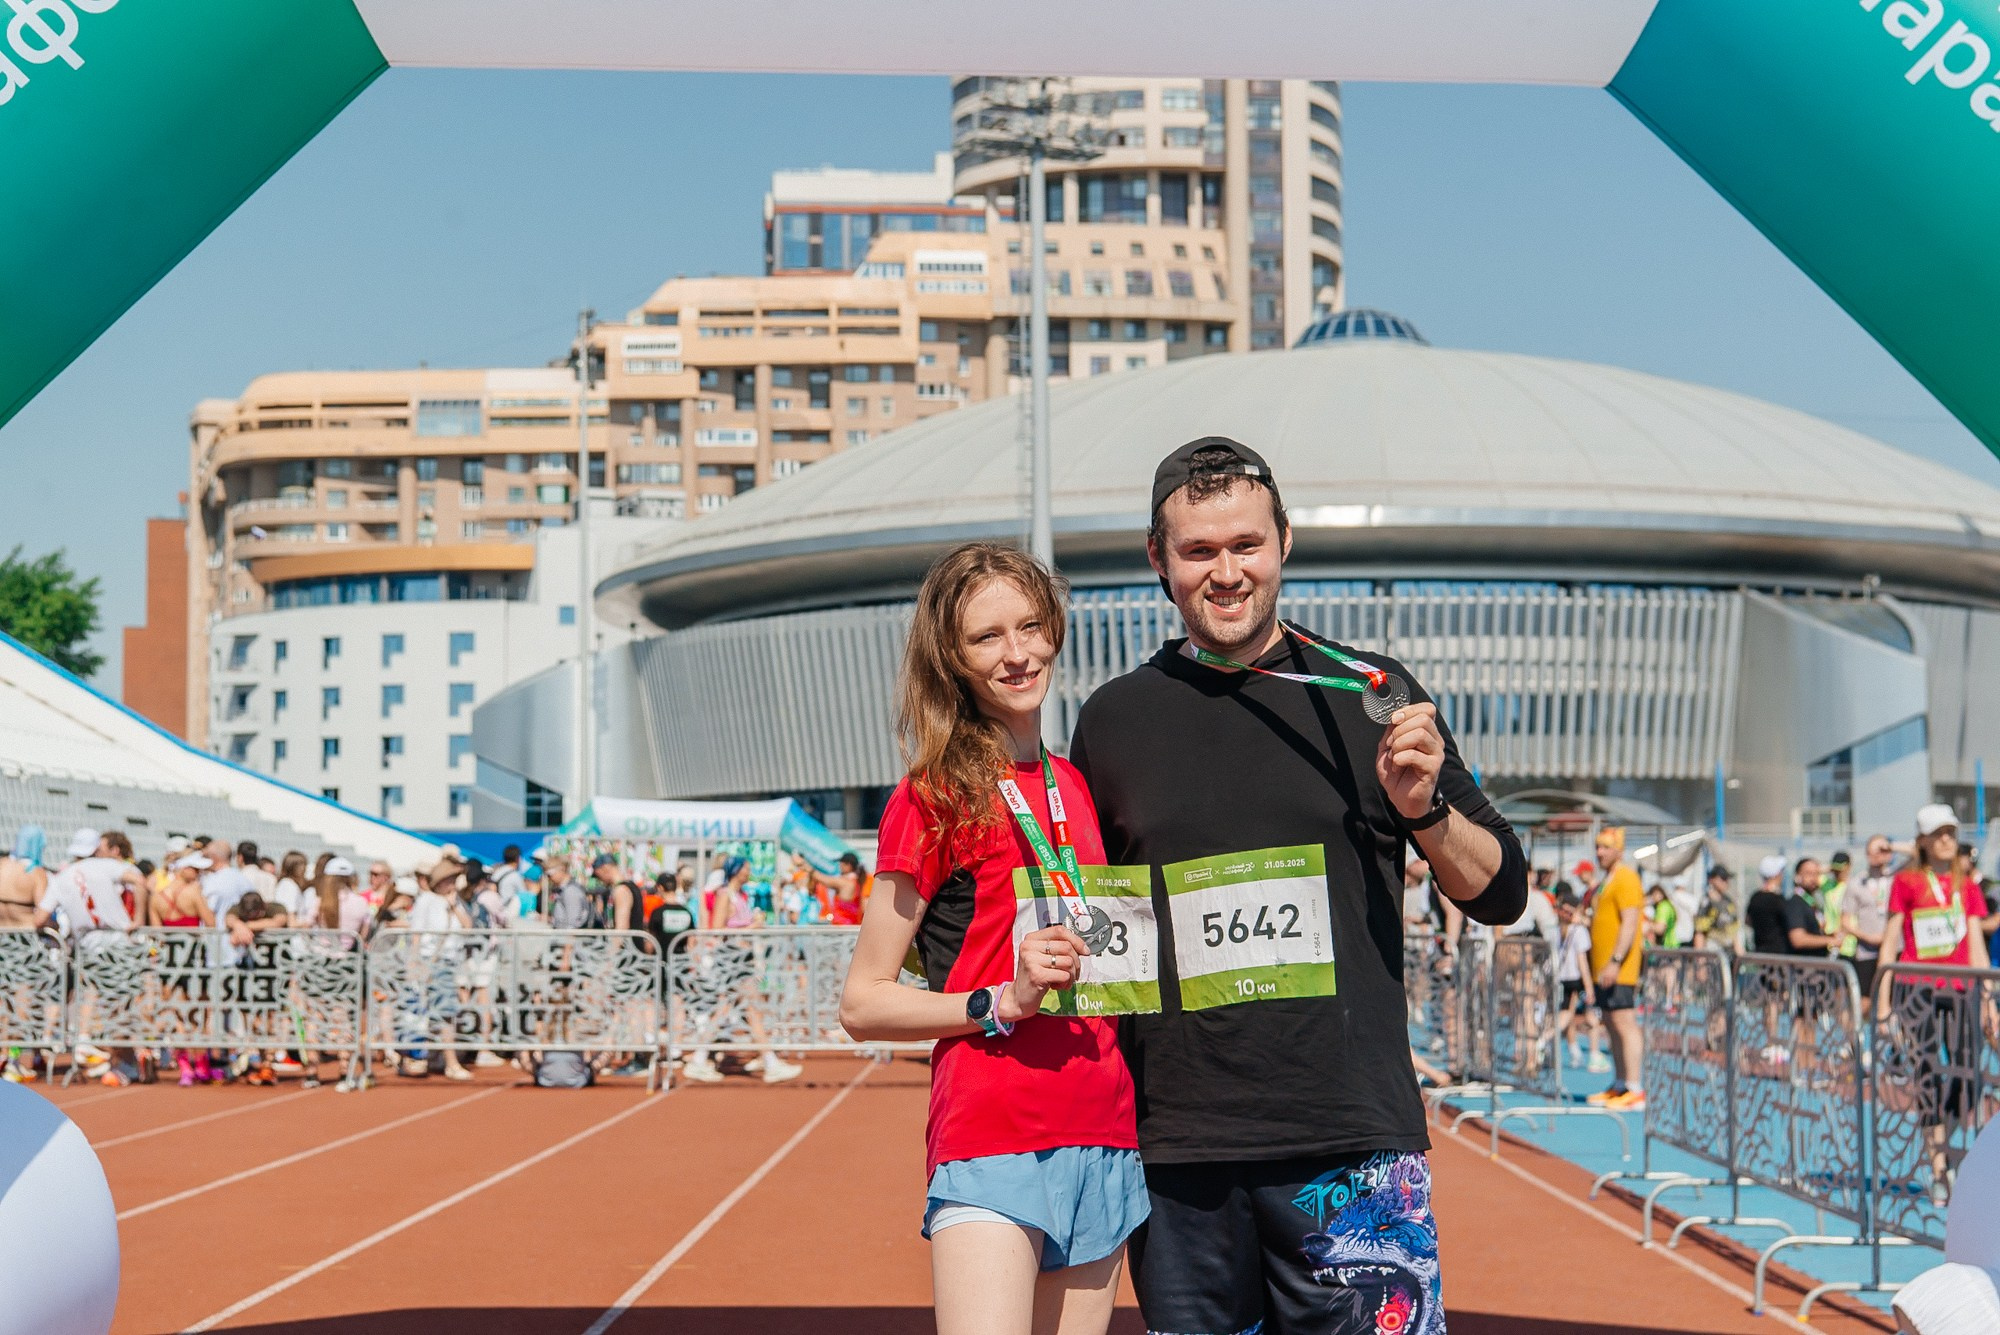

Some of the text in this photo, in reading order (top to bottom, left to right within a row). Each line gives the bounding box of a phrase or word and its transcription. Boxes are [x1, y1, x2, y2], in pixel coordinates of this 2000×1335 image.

[1005, 783, 1021, 810] URAL
[1051, 791, 1062, 816] URAL
[624, 816, 755, 838] ФИНИШ
[1038, 844, 1052, 862] СБЕР
[1065, 857, 1075, 873] СБЕР
[1264, 858, 1306, 869] 31.05.2025
[1096, 878, 1131, 887] 31.05.2025
[1202, 903, 1302, 948] 5642
[1313, 932, 1321, 949] 5642
[1235, 979, 1255, 996] 10
